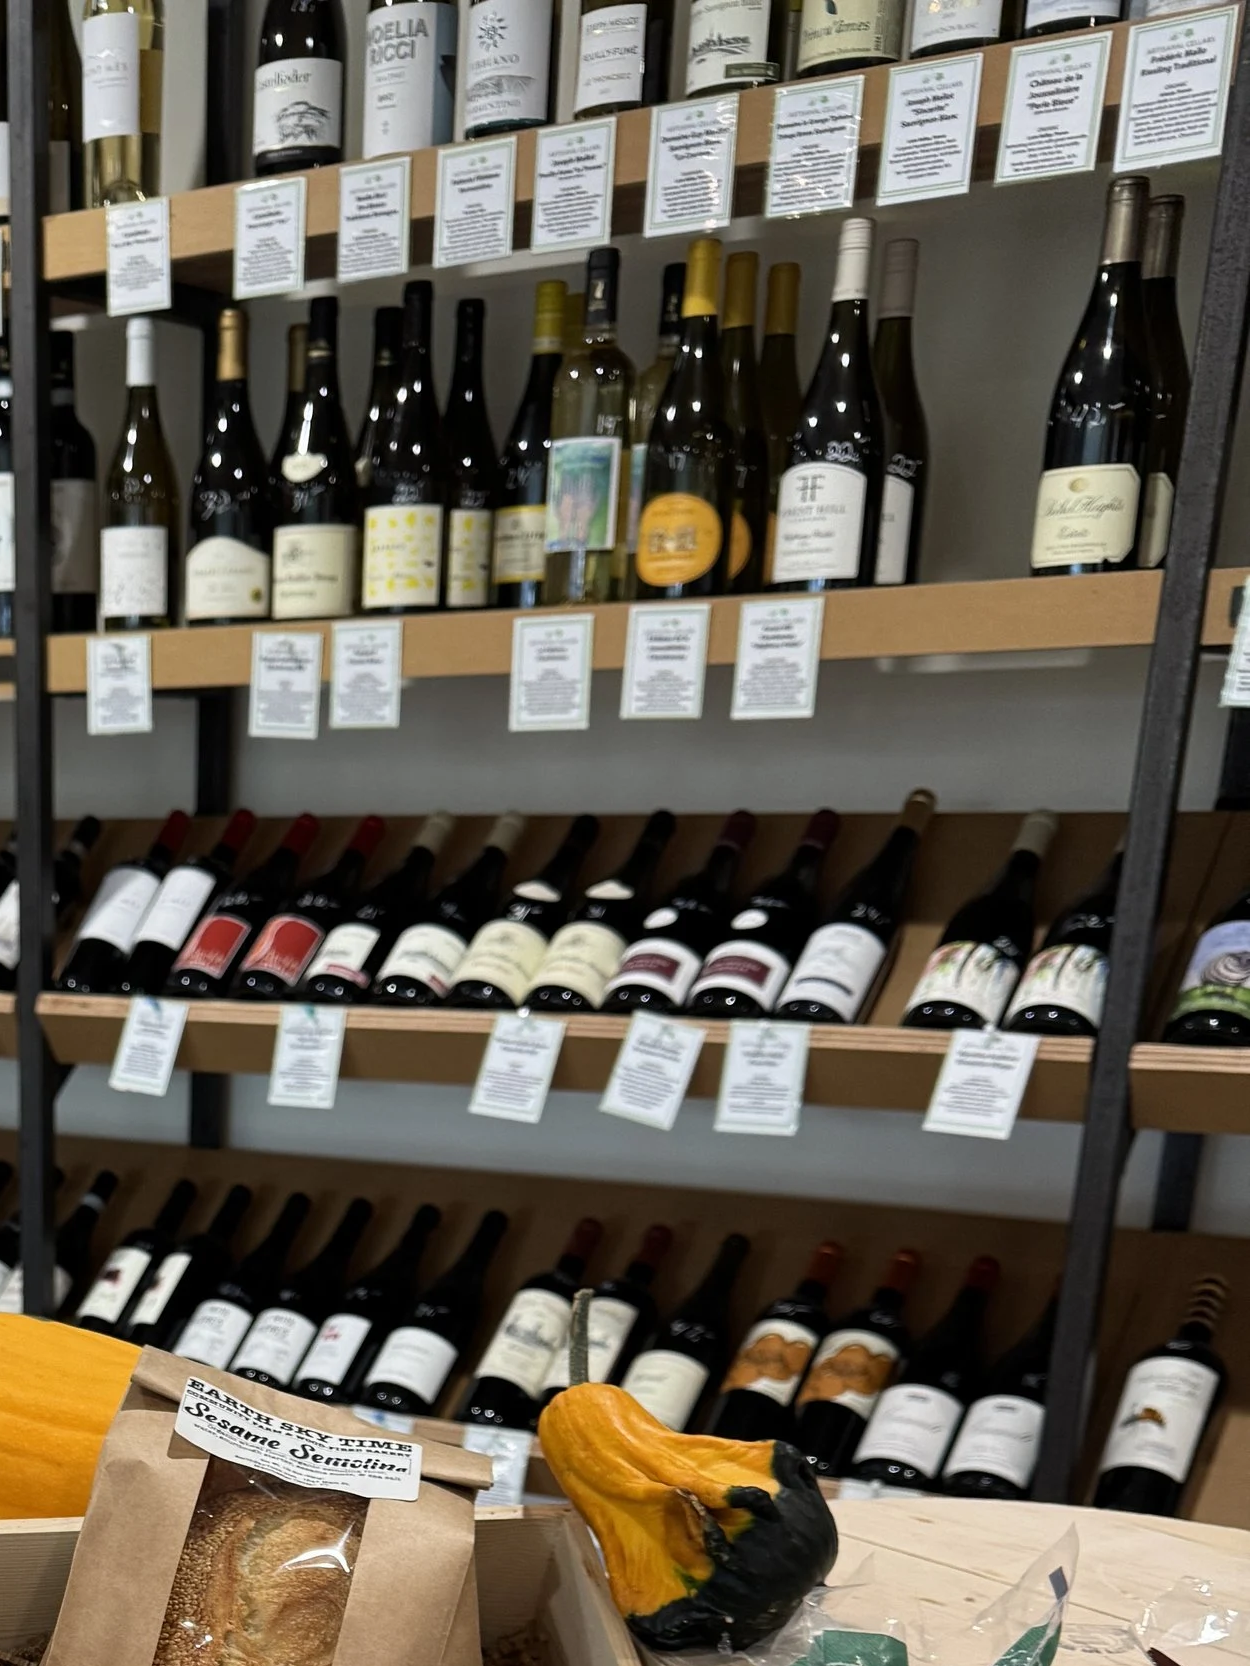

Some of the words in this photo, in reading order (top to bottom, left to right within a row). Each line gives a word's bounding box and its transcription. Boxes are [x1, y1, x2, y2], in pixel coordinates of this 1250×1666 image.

[1174, 55, 1217, 70] Traditional
[184, 1402, 281, 1450] Sesame
[289, 1443, 409, 1474] Semolina
[187, 1378, 273, 1427] EARTH
[279, 1421, 334, 1444] SKY
[339, 1437, 413, 1453] TIME
